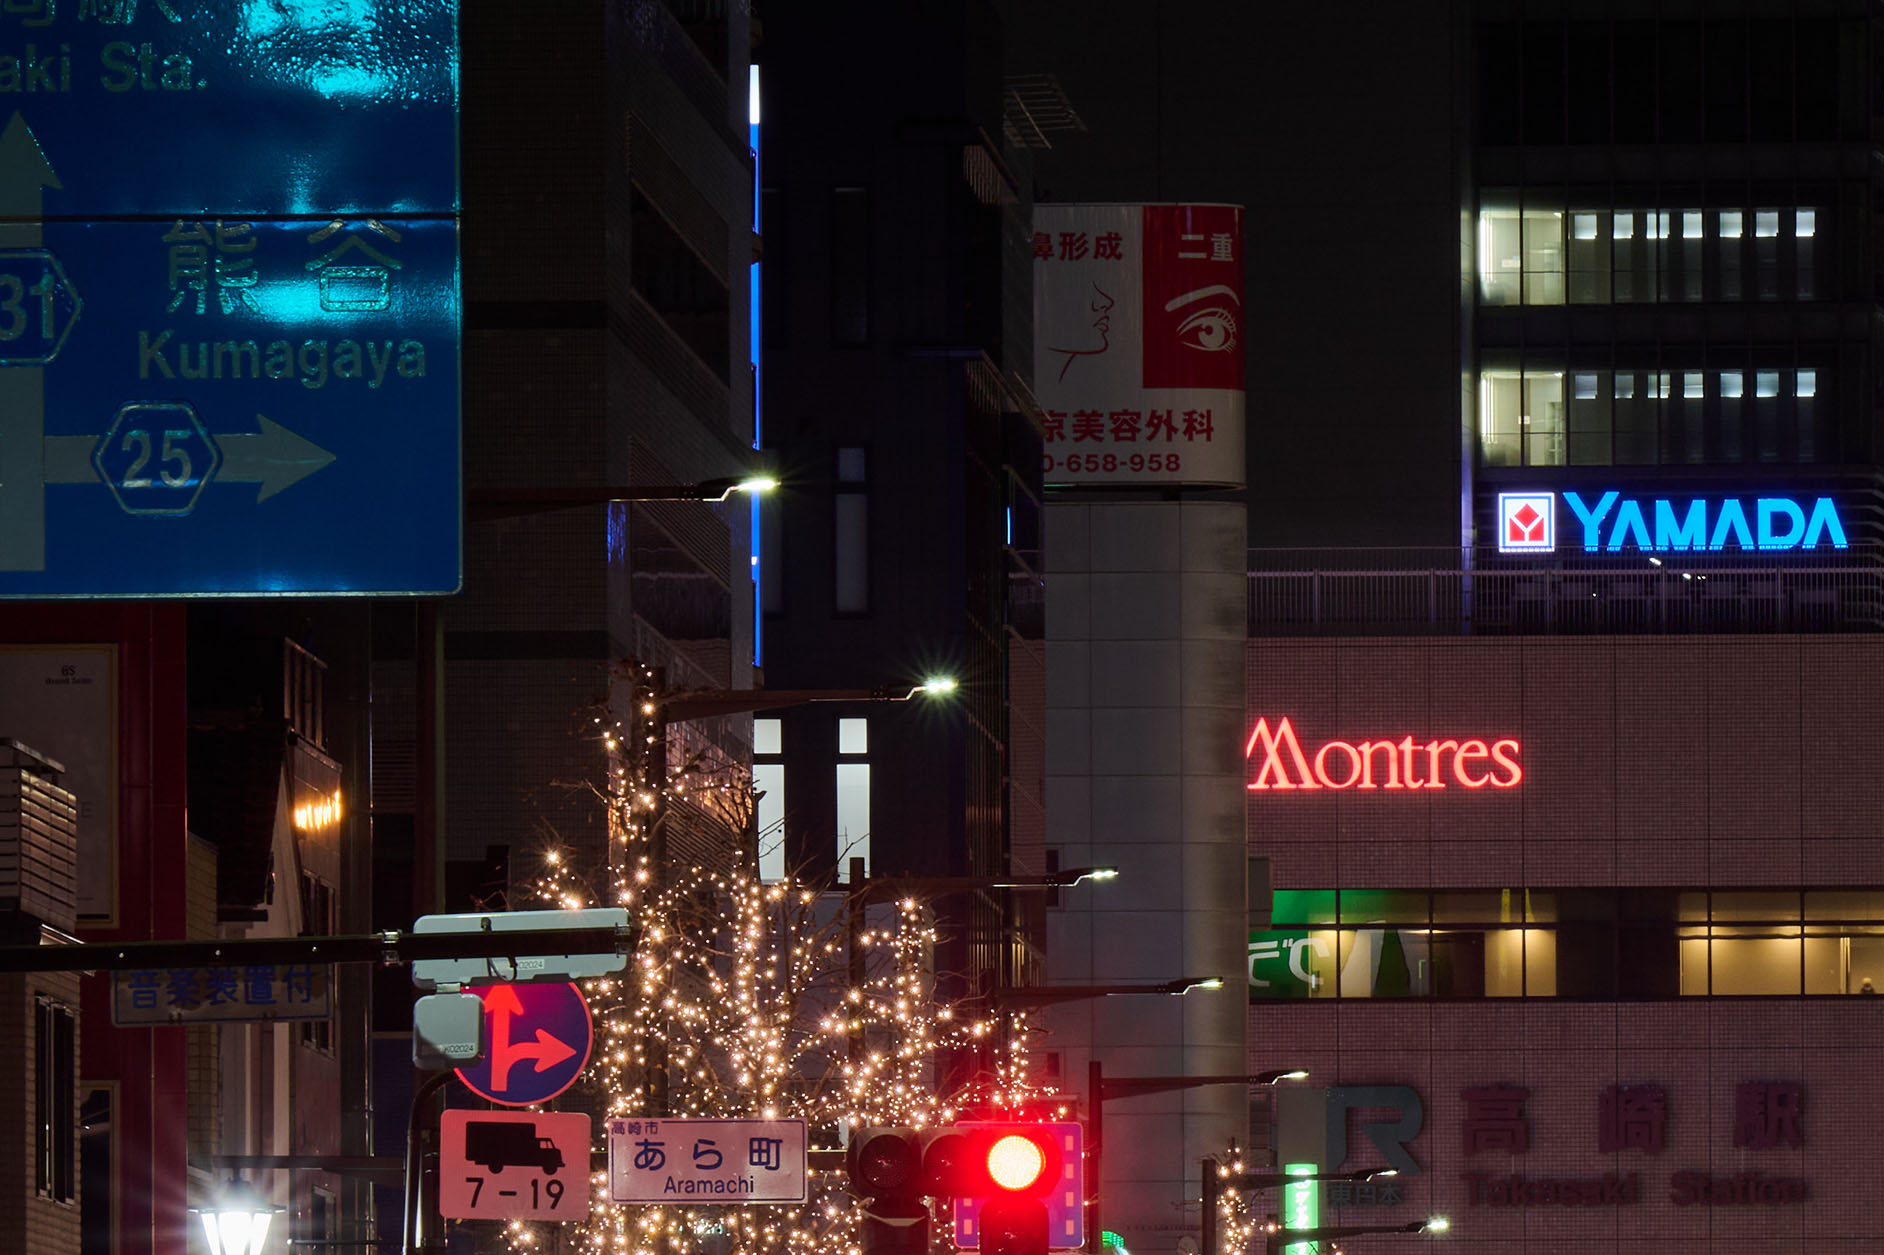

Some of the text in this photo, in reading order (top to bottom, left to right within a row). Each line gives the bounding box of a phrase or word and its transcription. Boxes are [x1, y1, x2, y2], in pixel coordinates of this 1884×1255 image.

[101, 41, 208, 92] Sta.
[161, 219, 402, 315] 熊谷
[1178, 232, 1234, 262] 二重
[138, 330, 427, 389] Kumagaya
[122, 430, 190, 488] 25
[1563, 491, 1848, 552] YAMADA
[1247, 716, 1523, 790] Montres
[611, 1121, 658, 1135] 高崎市
[1460, 1076, 1804, 1153] 高崎駅
[634, 1138, 783, 1170] あら町
[531, 1179, 565, 1209] 19
[664, 1176, 754, 1194] Aramachi
[1331, 1184, 1400, 1207] 東日本
